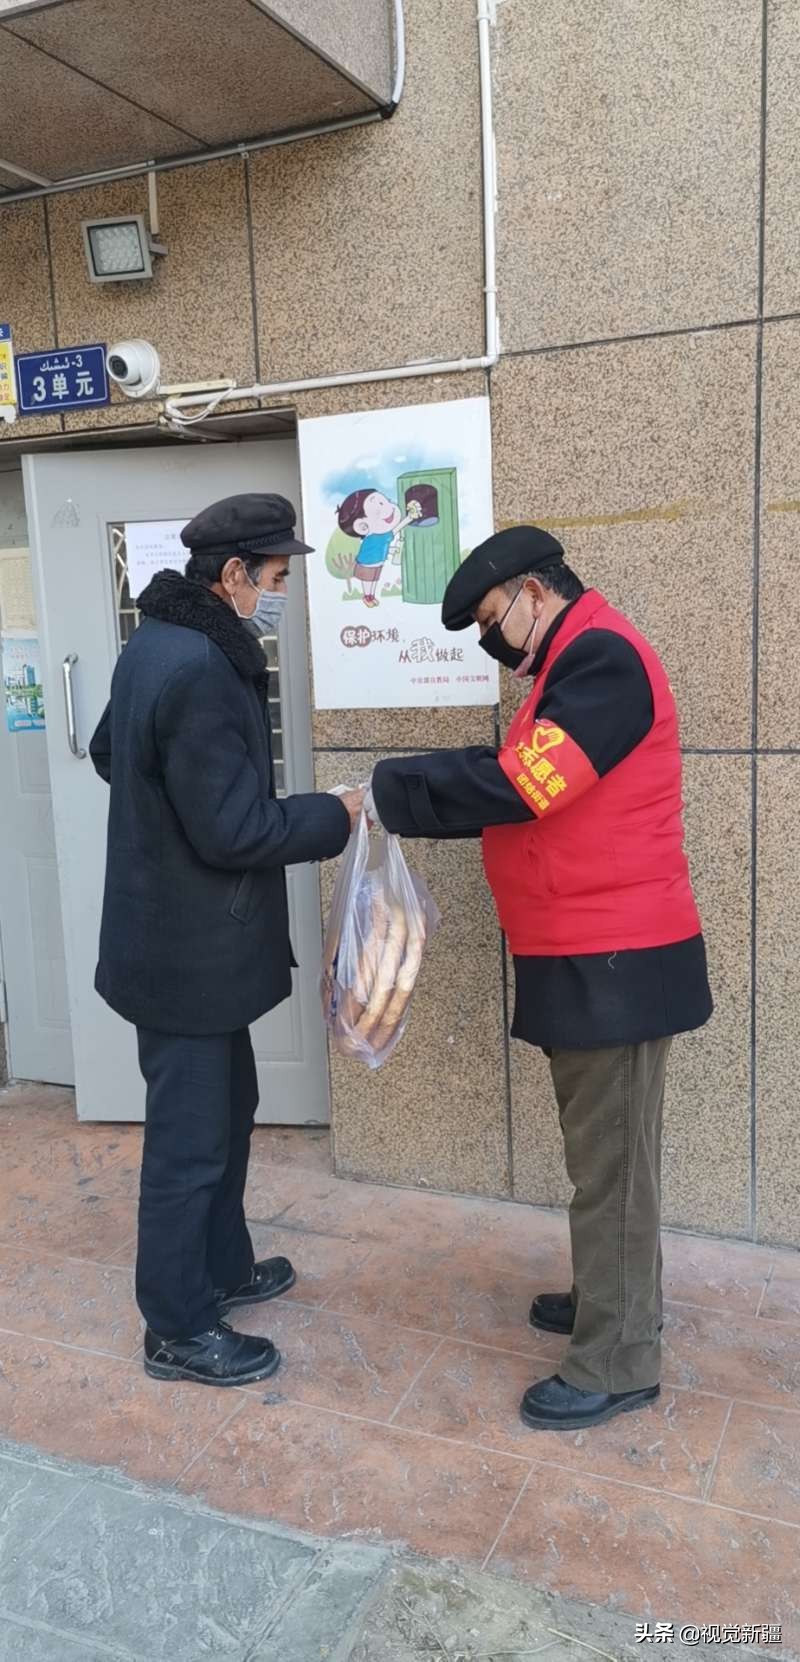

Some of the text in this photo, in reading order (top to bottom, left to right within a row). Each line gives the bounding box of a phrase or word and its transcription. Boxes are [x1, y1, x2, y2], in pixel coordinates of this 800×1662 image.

[33, 371, 94, 402] 3单元
[398, 637, 463, 663] 从我做起
